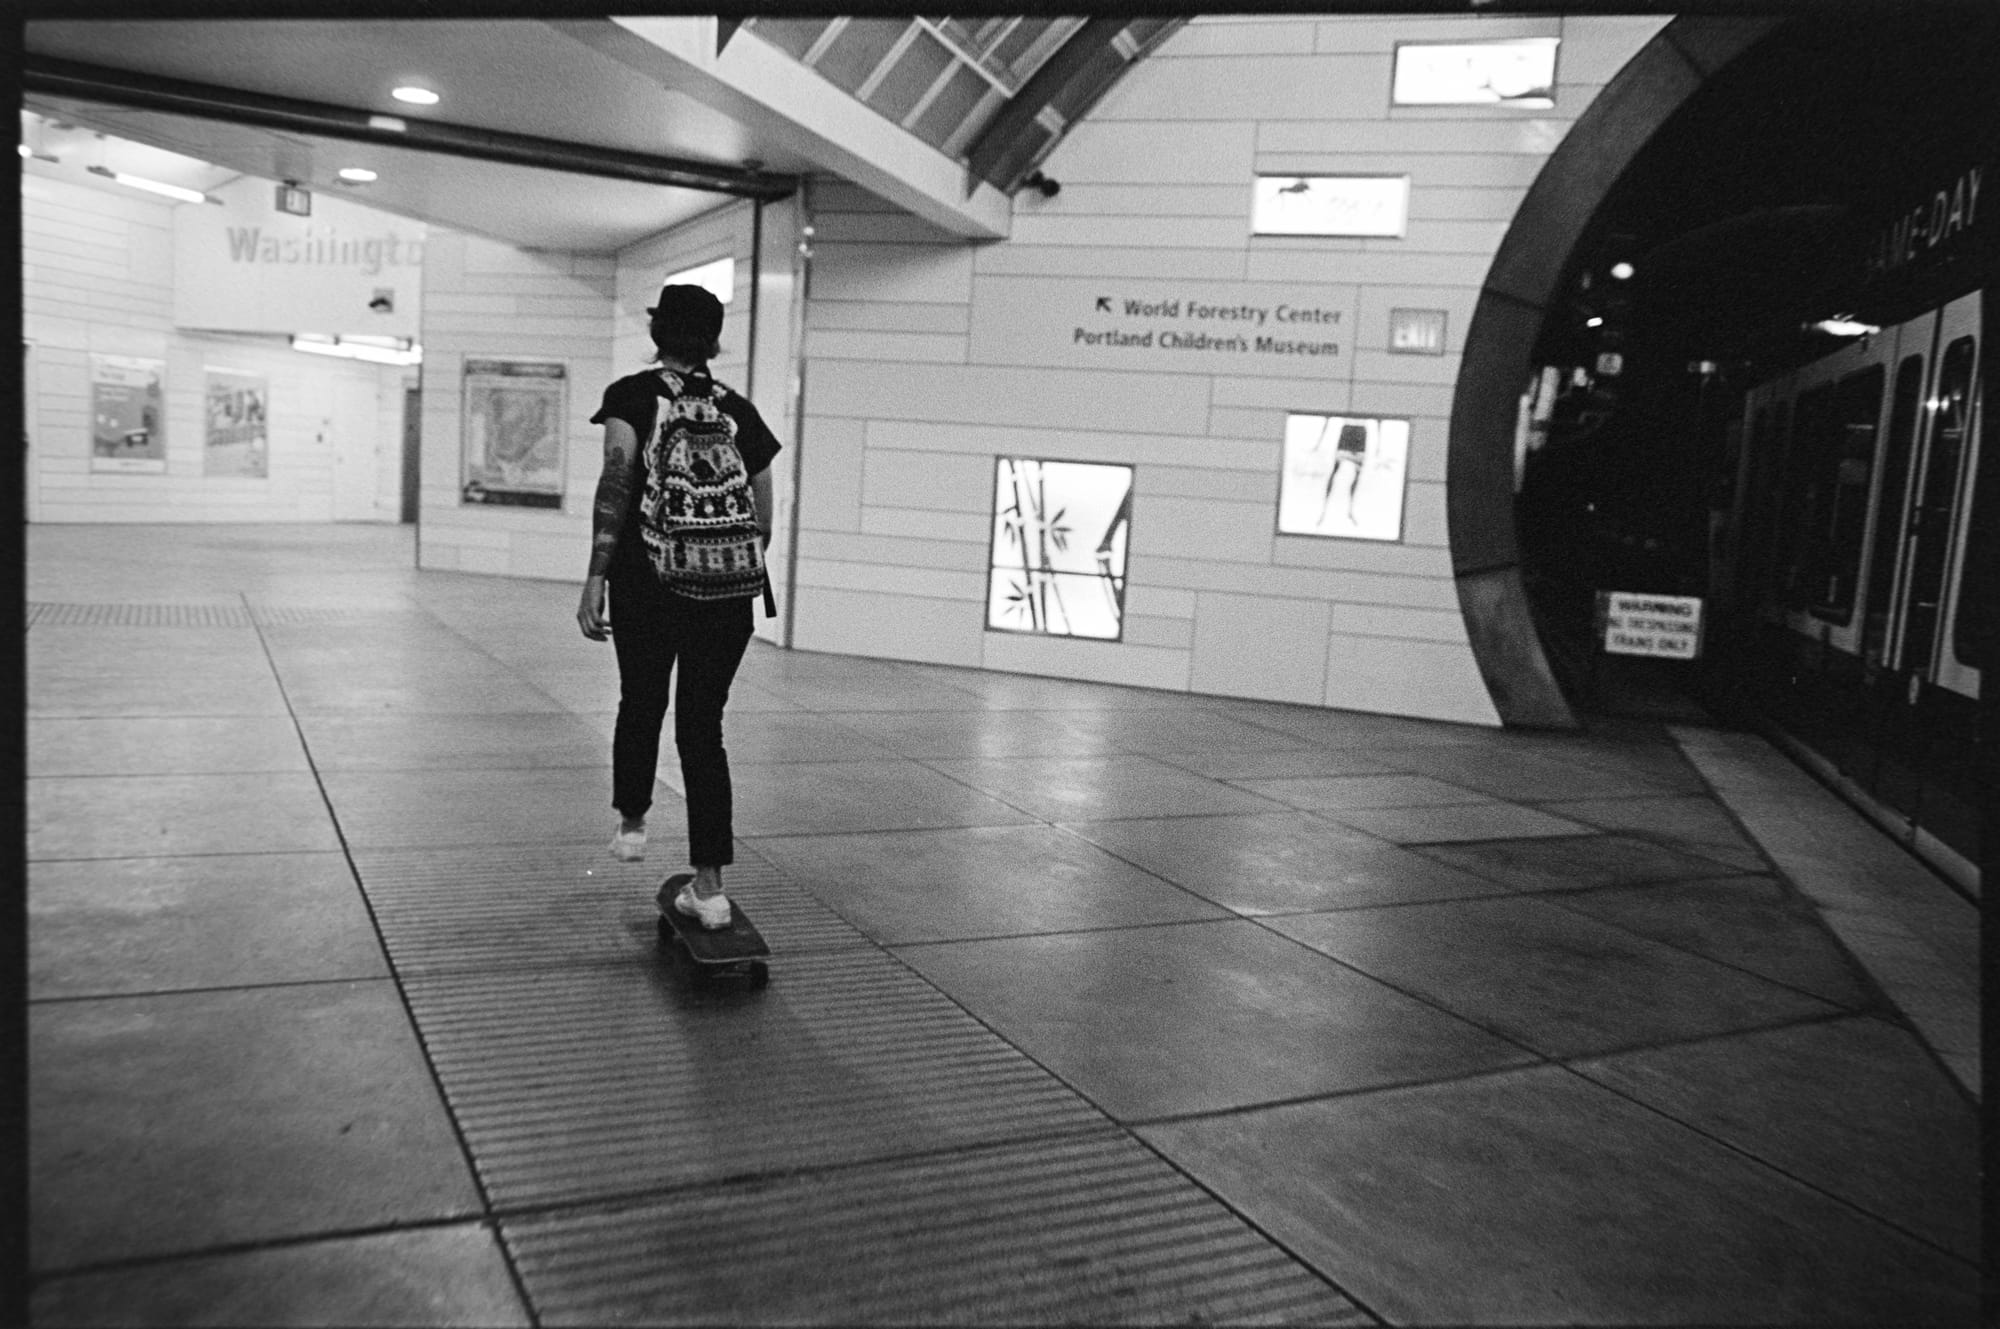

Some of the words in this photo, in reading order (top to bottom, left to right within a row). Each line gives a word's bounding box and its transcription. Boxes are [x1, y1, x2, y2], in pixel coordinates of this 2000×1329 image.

[1124, 299, 1179, 317] World
[1187, 301, 1269, 327] Forestry
[1276, 304, 1341, 323] Center
[1074, 327, 1153, 347] Portland
[1160, 331, 1249, 352] Children's
[1256, 336, 1338, 356] Museum
[1618, 601, 1693, 617] WARNING
